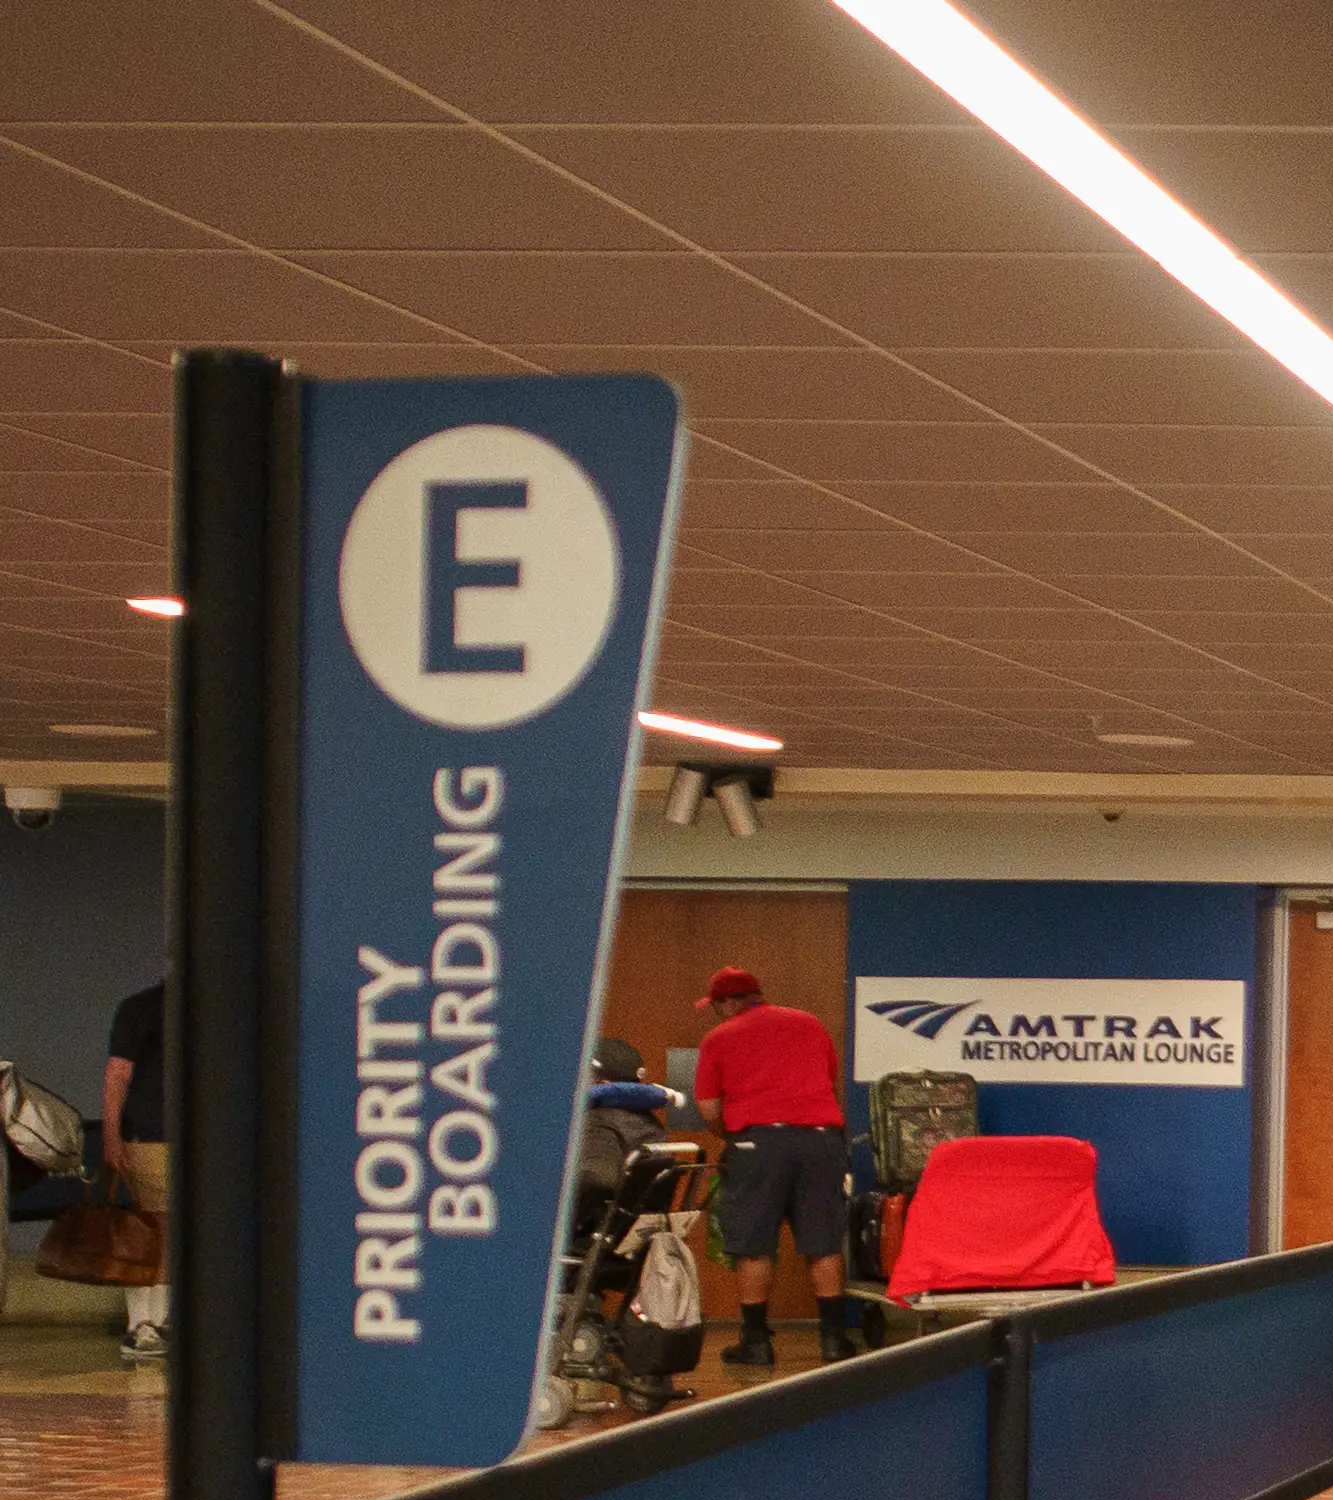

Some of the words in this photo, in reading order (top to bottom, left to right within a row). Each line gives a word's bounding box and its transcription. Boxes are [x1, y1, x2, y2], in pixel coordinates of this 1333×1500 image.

[422, 479, 530, 676] E
[427, 765, 504, 1237] BOARDING
[961, 1040, 1135, 1063] METROPOLITAN
[1143, 1042, 1235, 1065] LOUNGE
[964, 1014, 1224, 1040] AMTRAK
[354, 946, 426, 1344] PRIORITY
